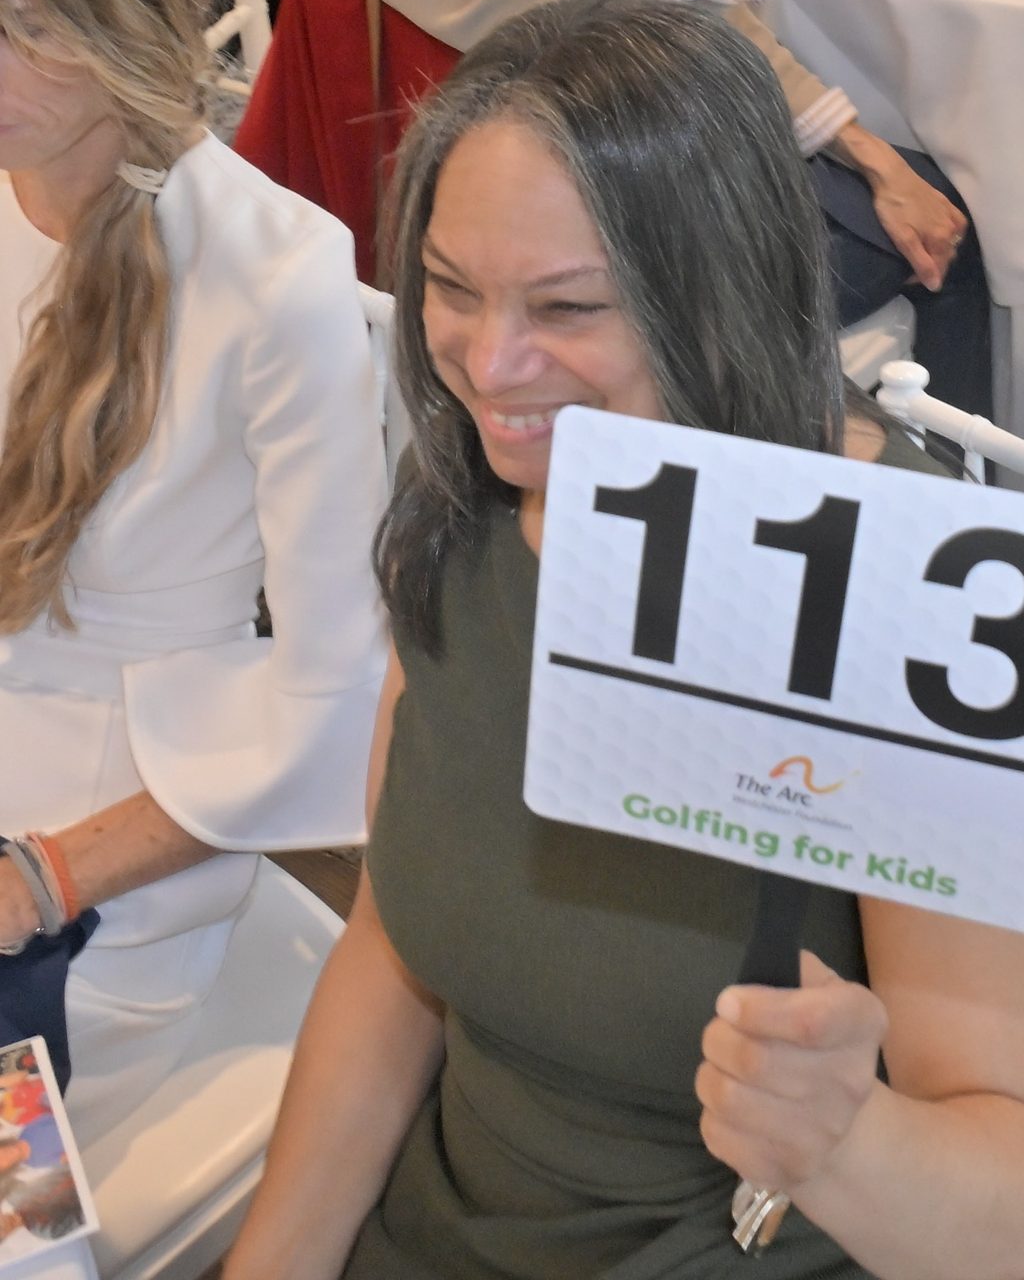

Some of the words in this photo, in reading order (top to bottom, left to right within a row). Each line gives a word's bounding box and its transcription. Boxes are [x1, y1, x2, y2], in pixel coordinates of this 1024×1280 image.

[736, 773, 772, 797] The
[780, 785, 813, 808] Arc
[622, 793, 780, 858] Golfing
[792, 835, 855, 870] for
[866, 853, 957, 896] Kids
